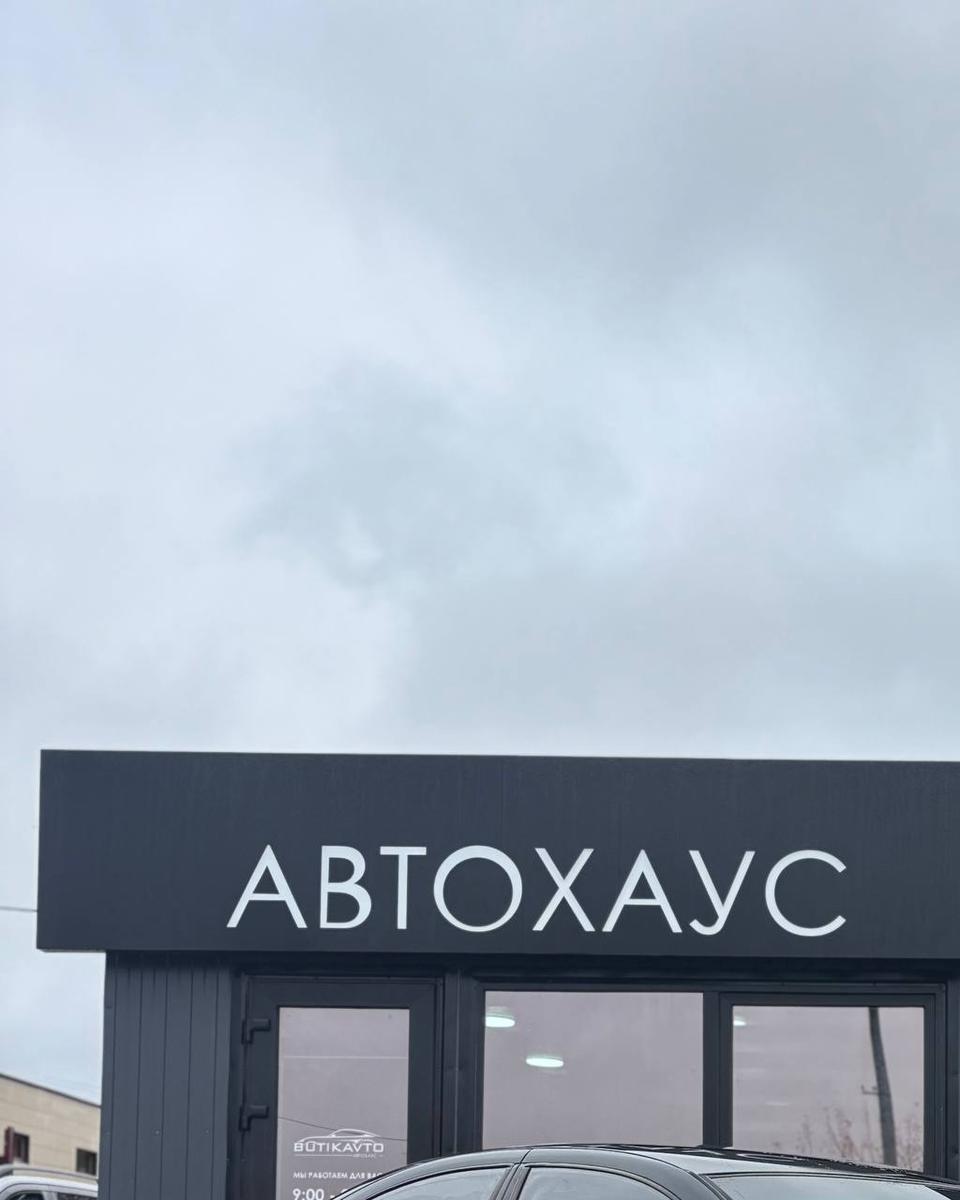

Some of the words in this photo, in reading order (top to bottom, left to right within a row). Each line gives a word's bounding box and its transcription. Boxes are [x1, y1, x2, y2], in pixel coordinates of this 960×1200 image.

[226, 844, 848, 937] АВТОХАУС
[294, 1142, 384, 1152] BUTIKAVTO
[292, 1171, 307, 1179] МЫ
[308, 1171, 348, 1179] РАБОТАЕМ
[349, 1171, 365, 1180] ДЛЯ
